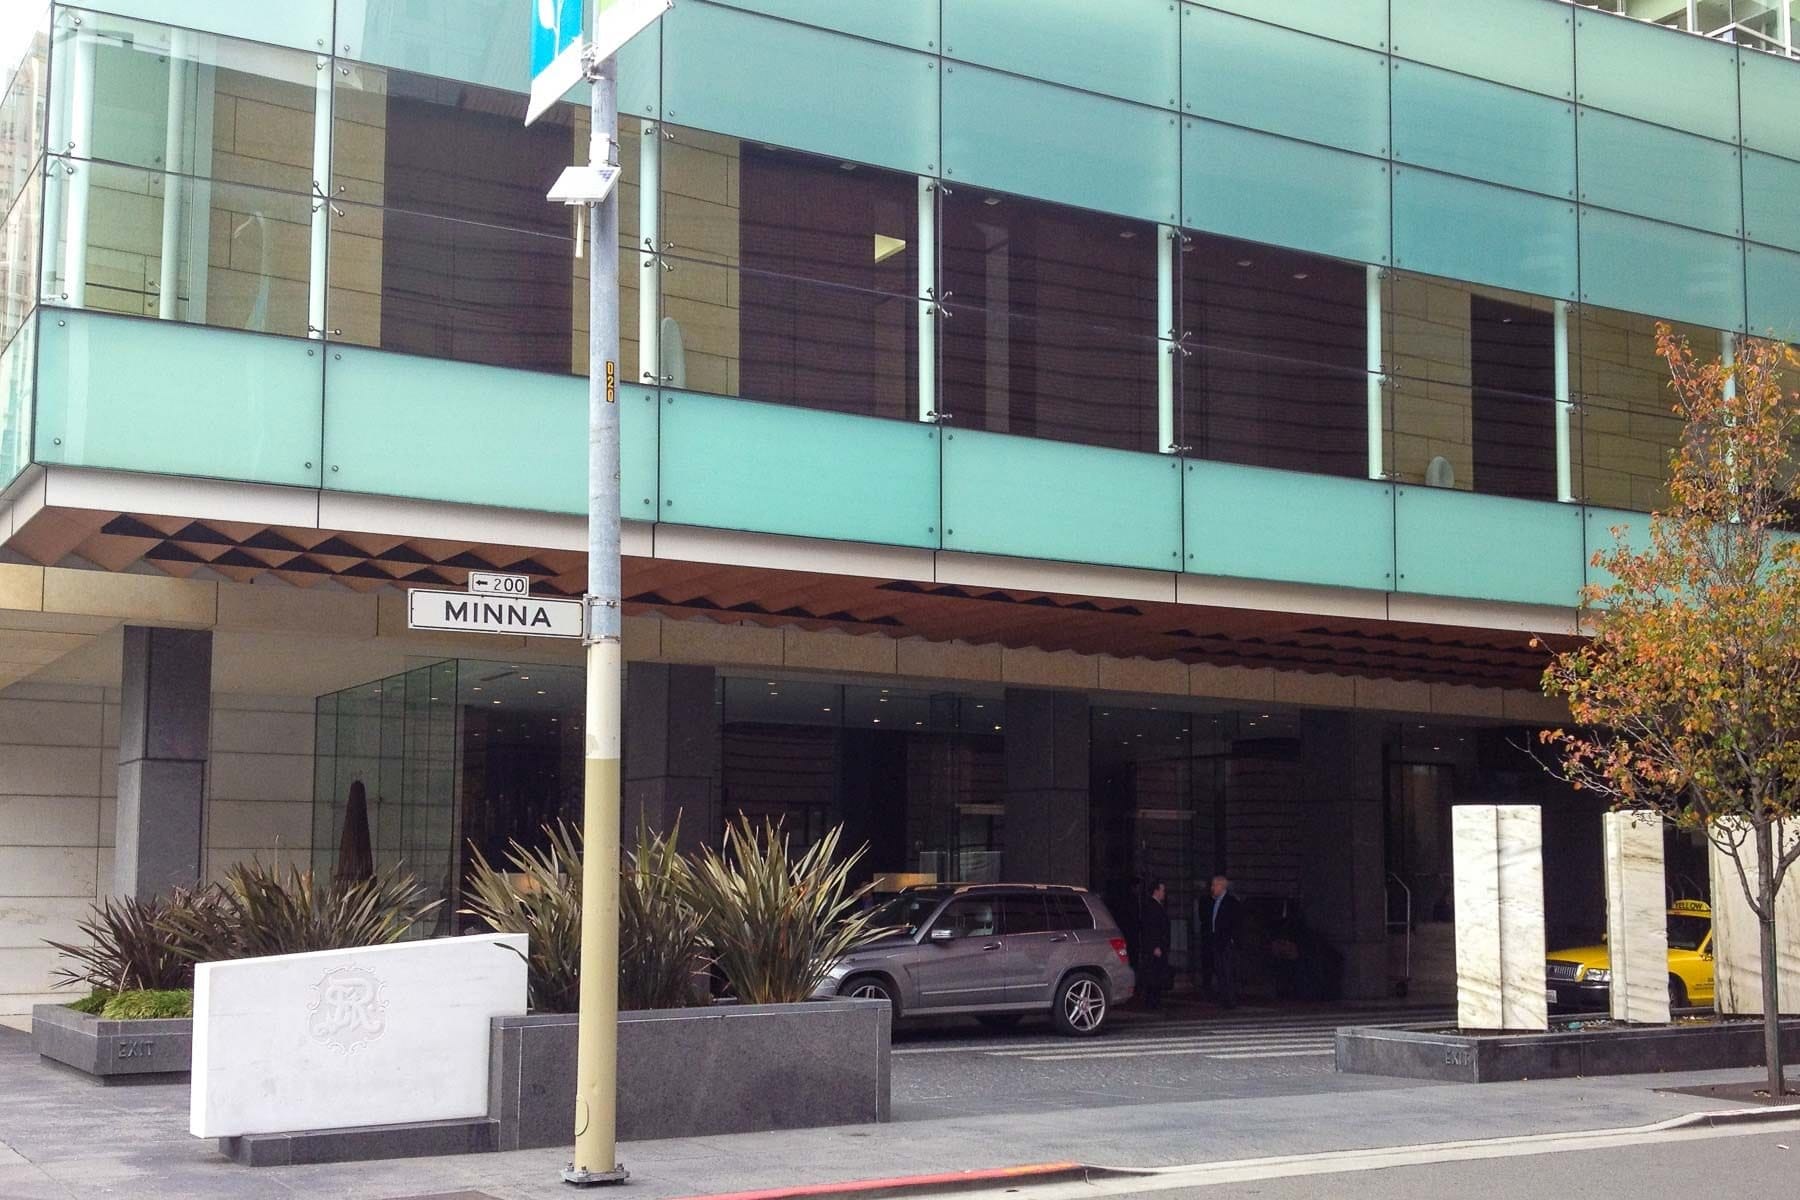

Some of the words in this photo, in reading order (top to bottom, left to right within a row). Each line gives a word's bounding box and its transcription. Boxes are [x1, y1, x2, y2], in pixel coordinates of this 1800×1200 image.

[493, 578, 525, 593] 200
[445, 600, 552, 628] MINNA
[1674, 902, 1703, 911] YELLOW
[118, 1040, 154, 1060] EXIT
